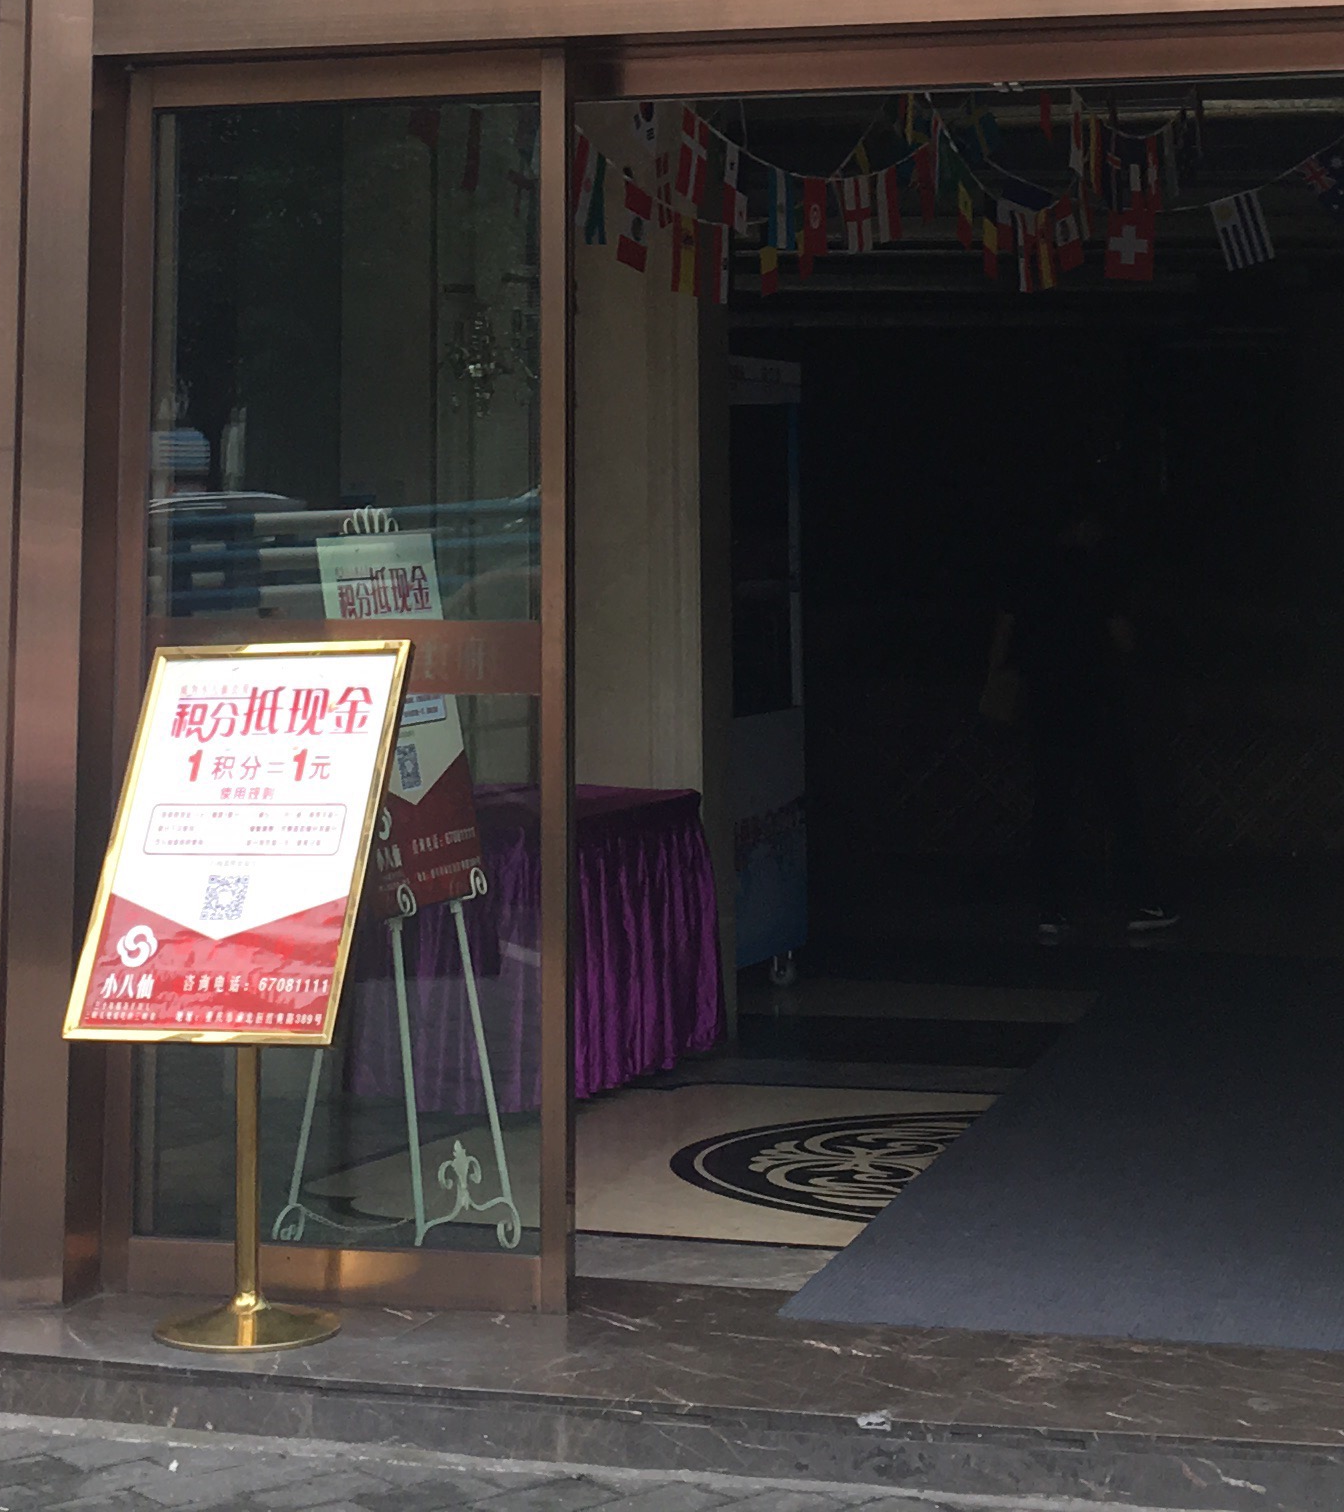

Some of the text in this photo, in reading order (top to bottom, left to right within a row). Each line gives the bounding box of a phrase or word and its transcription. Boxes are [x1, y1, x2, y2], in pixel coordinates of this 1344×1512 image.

[171, 686, 374, 744] 积分抵现金
[100, 972, 156, 1000] 小八仙
